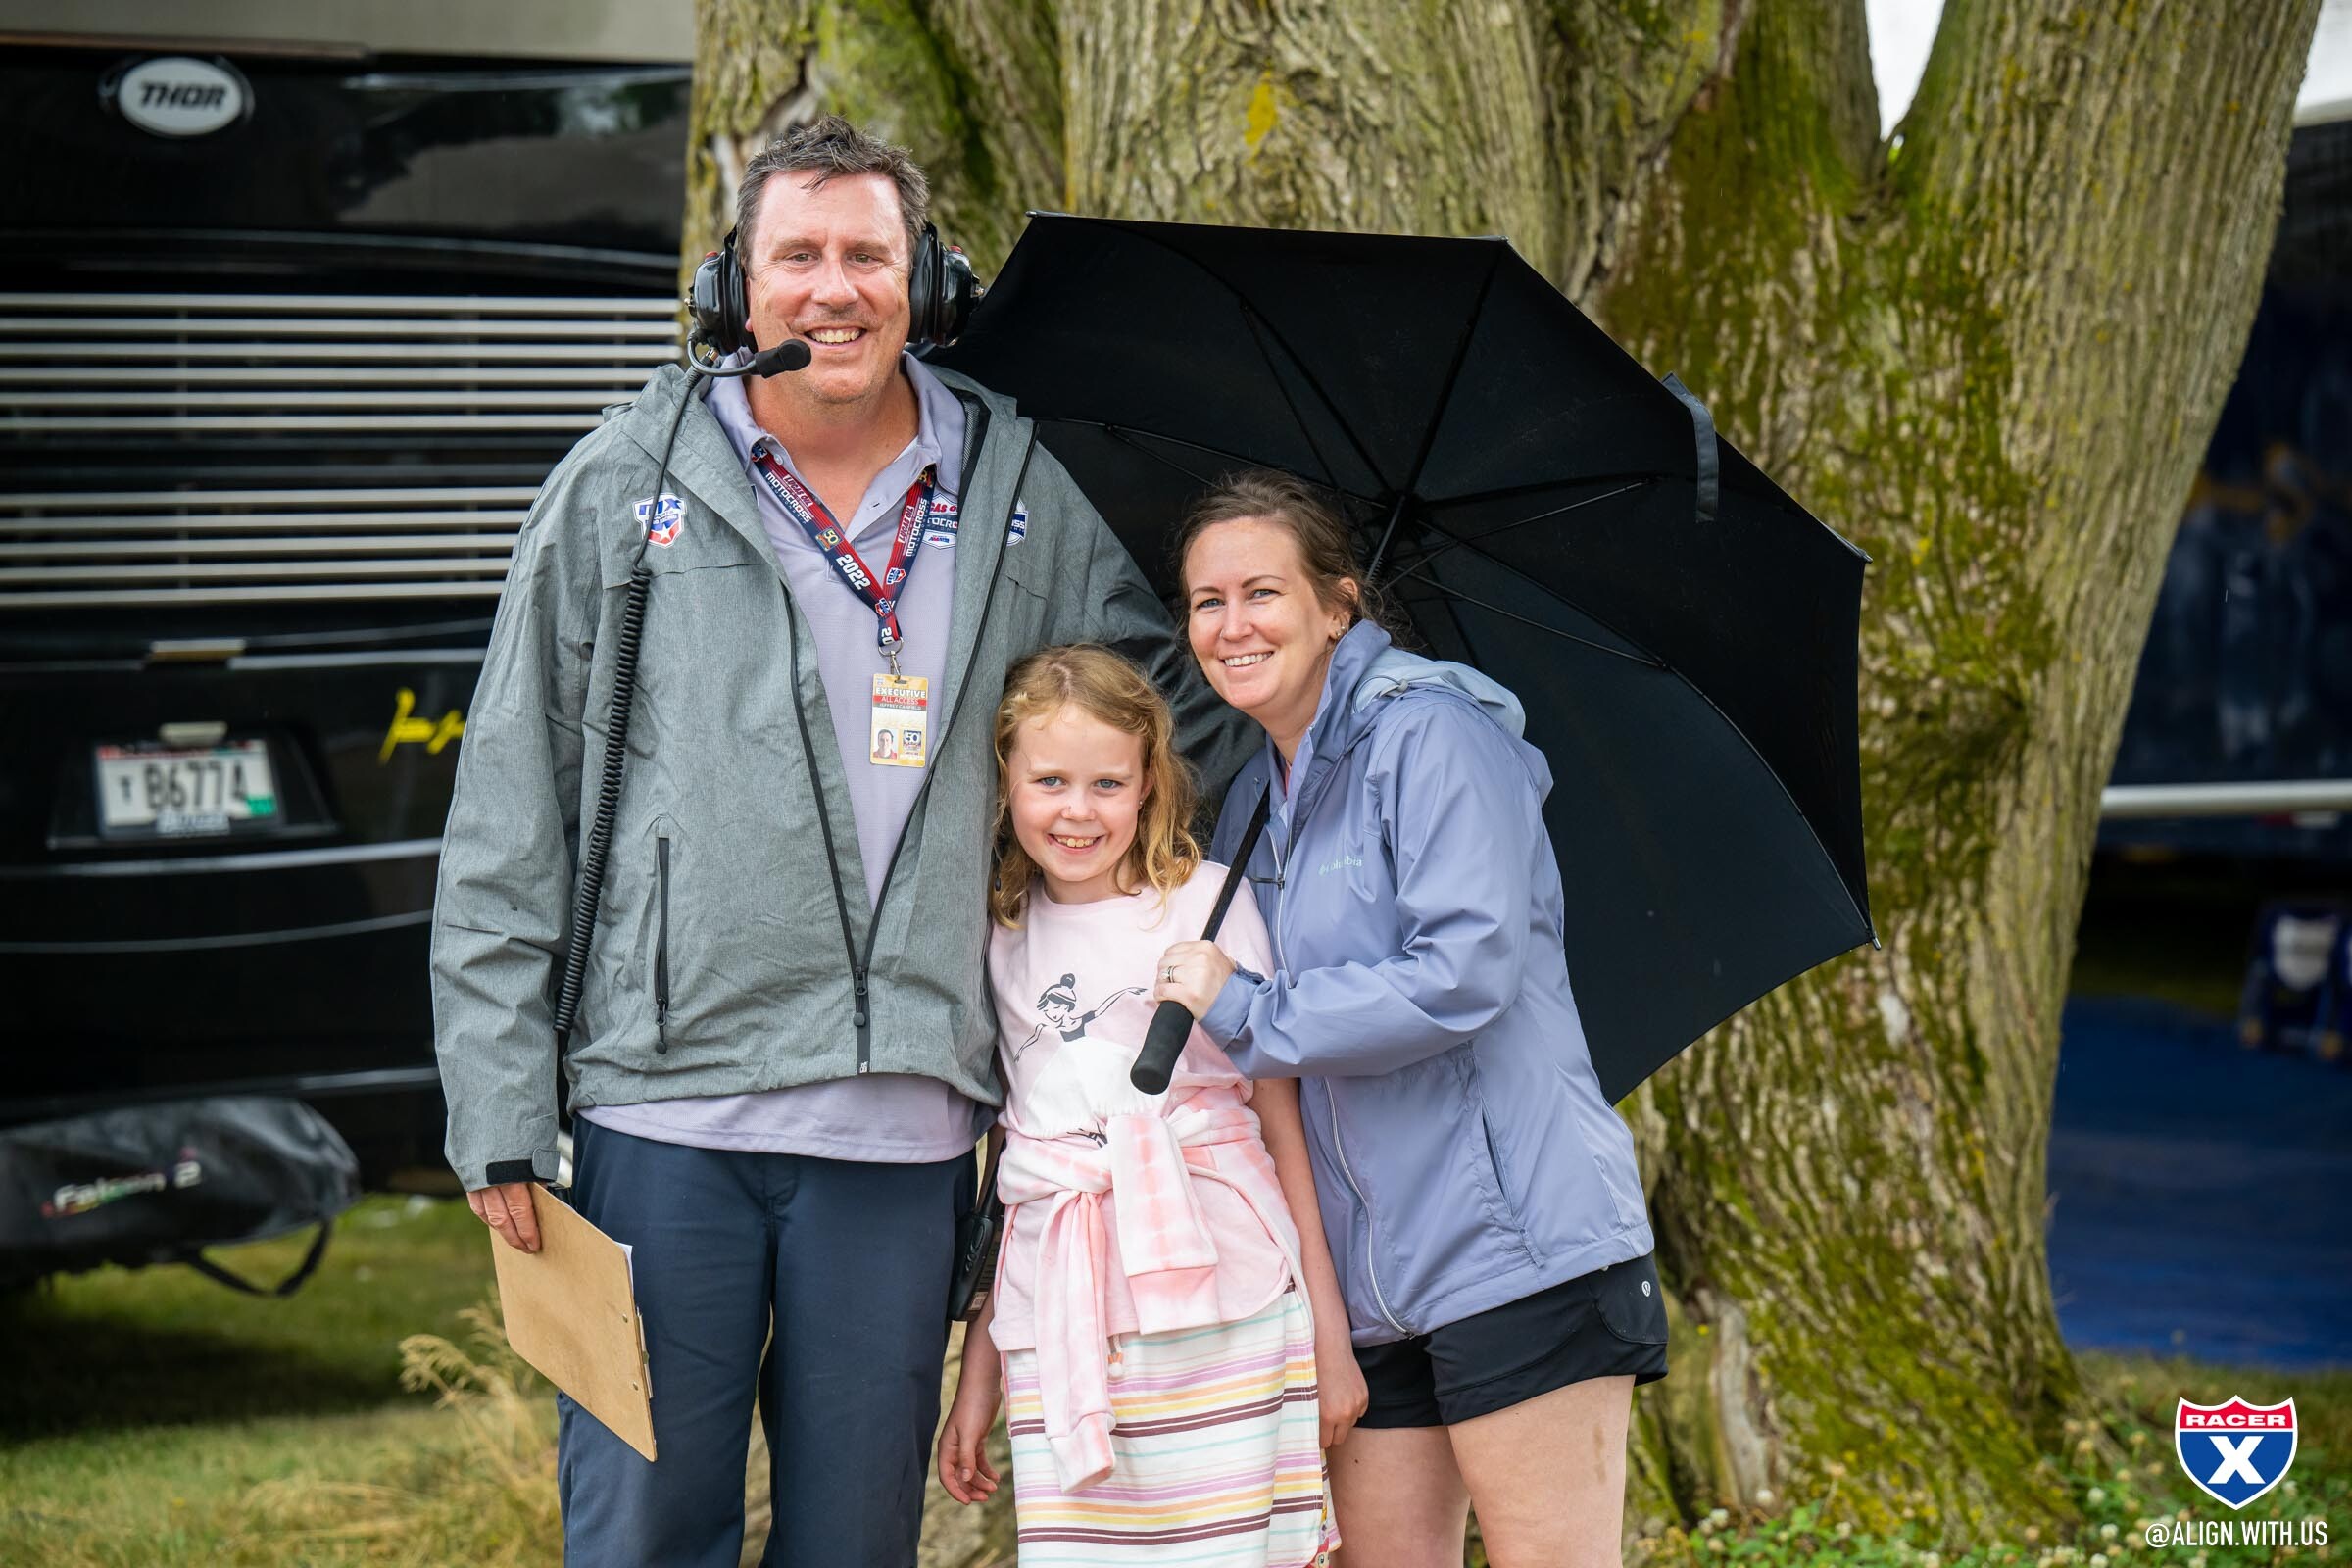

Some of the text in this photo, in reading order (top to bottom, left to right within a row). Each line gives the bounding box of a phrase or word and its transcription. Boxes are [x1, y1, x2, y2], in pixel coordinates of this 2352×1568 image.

[140, 80, 227, 111] THOR
[765, 472, 812, 522] MOTOCROSS
[784, 475, 813, 507] LUCAS OIL
[822, 529, 840, 546] 50
[897, 518, 910, 542] LUCAS
[905, 506, 914, 519] OIL
[905, 498, 928, 557] MOTOCROSS
[836, 554, 870, 590] 2022
[876, 687, 926, 698] EXECUTIVE
[881, 695, 919, 706] ALL ACCESS
[904, 732, 921, 745] 50
